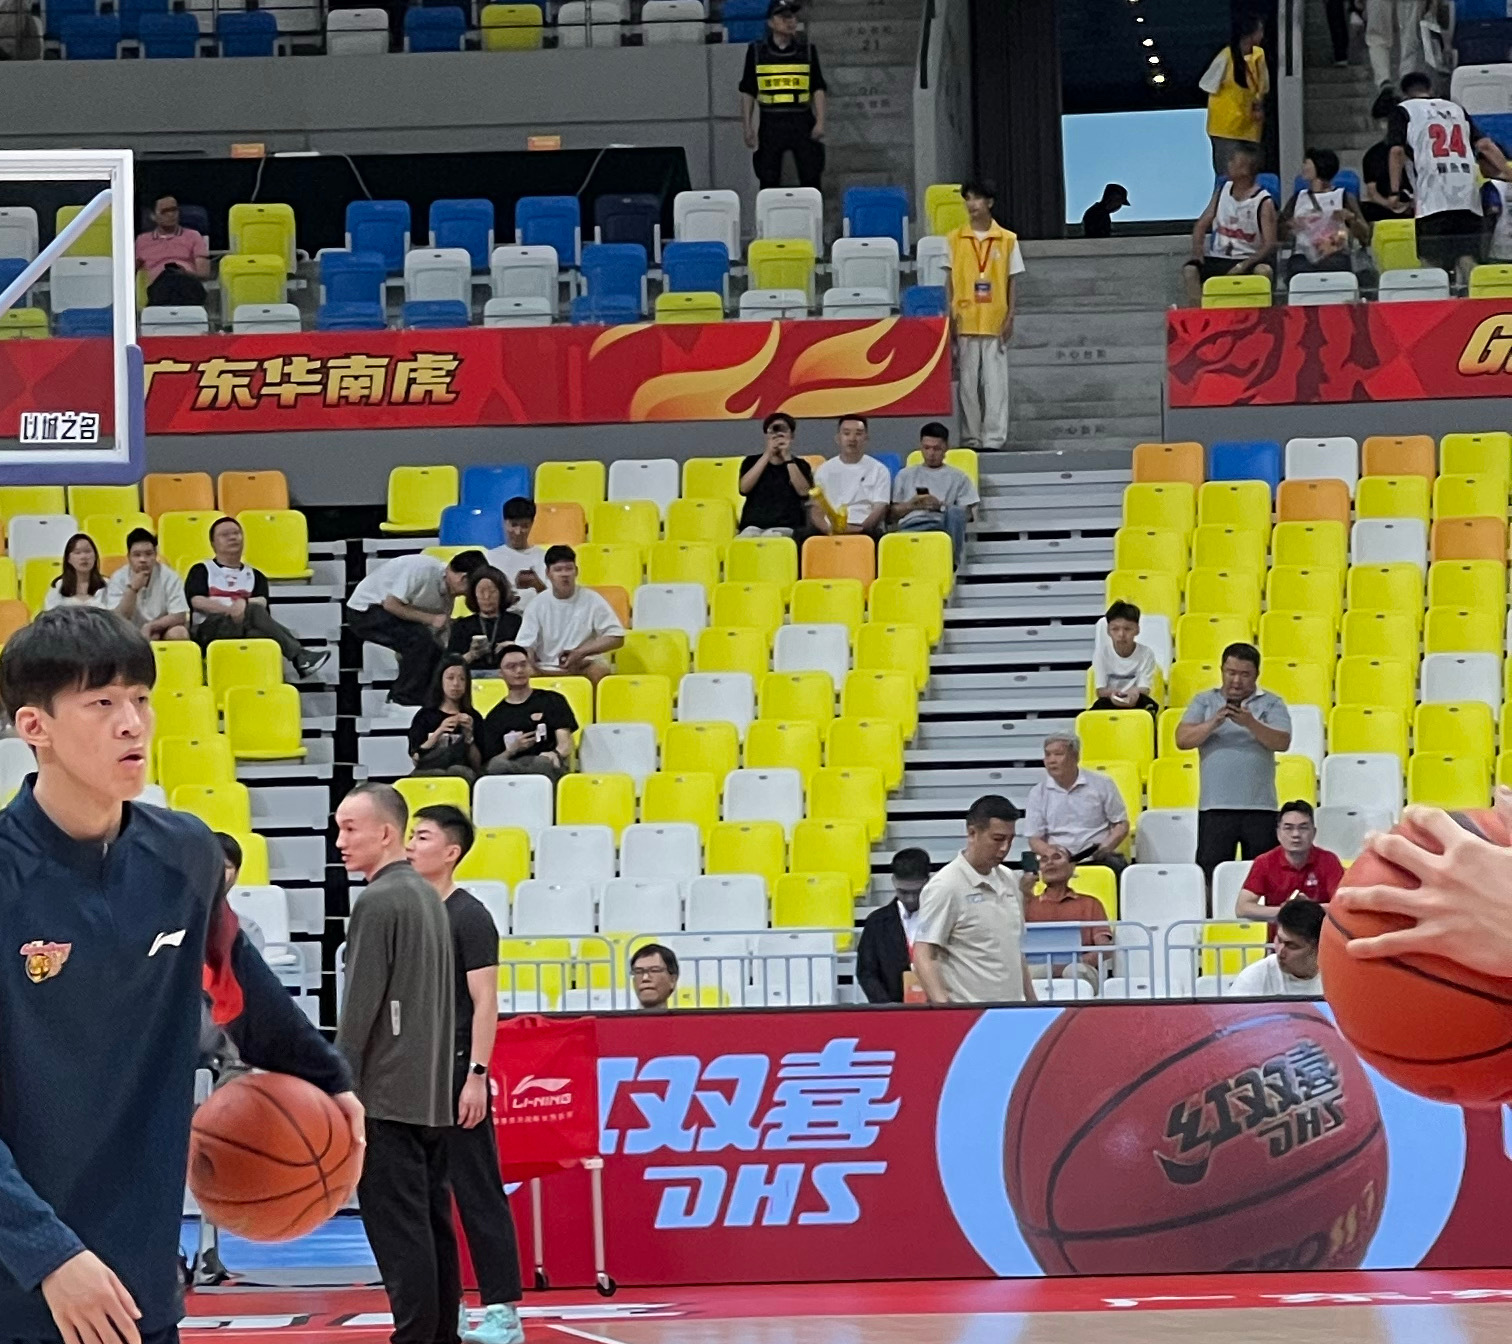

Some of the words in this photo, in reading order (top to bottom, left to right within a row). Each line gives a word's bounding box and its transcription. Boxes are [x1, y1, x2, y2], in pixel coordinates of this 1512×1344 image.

[1428, 124, 1466, 158] 24
[143, 351, 463, 409] 广东华南虎
[512, 1093, 572, 1109] LI-NING
[1255, 1096, 1346, 1158] DHS
[643, 1160, 888, 1229] DHS
